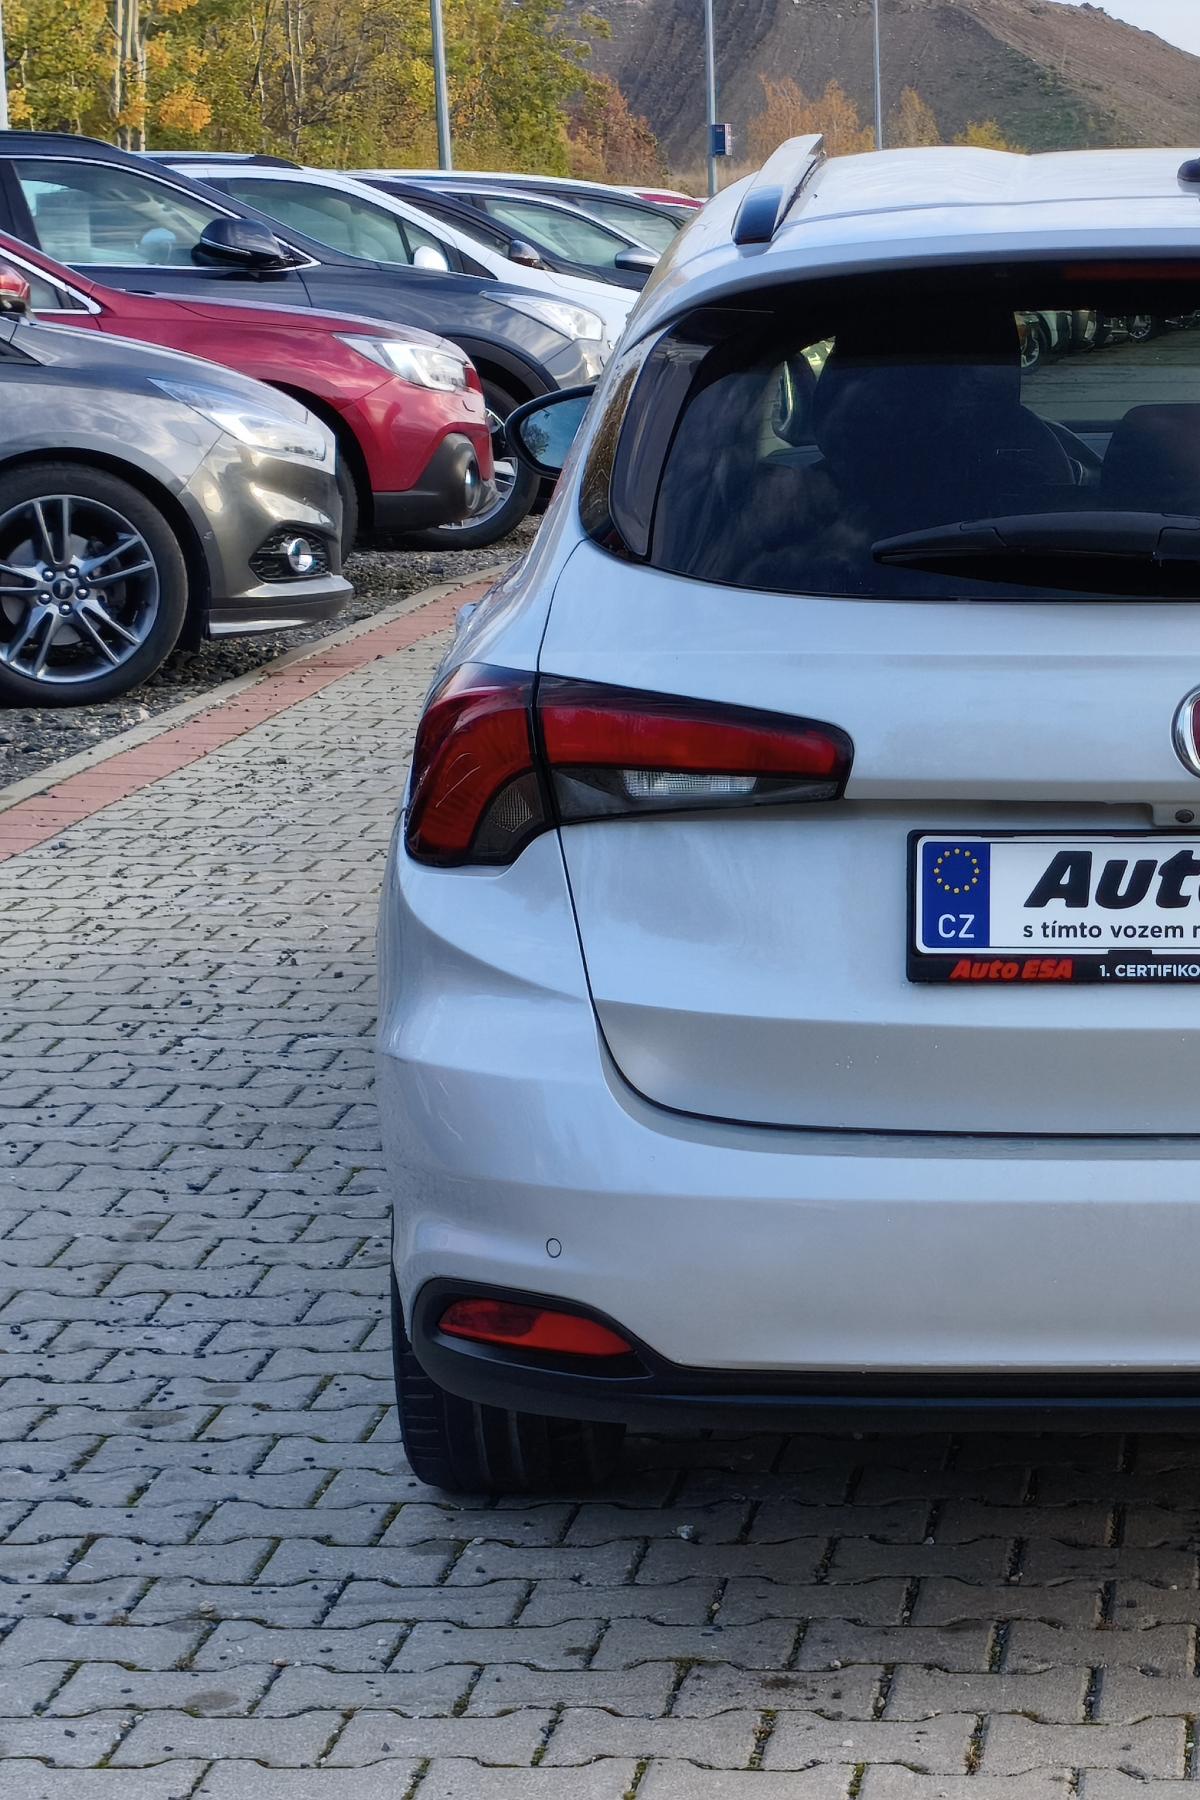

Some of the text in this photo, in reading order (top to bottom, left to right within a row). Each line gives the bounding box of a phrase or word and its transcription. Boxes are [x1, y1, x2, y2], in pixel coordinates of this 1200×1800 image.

[938, 914, 975, 938] CZ
[1023, 925, 1033, 938] s
[1041, 920, 1101, 938] tímto
[1110, 925, 1184, 938] vozem
[950, 959, 1073, 980] Auto ESA
[1100, 965, 1110, 977] 1.
